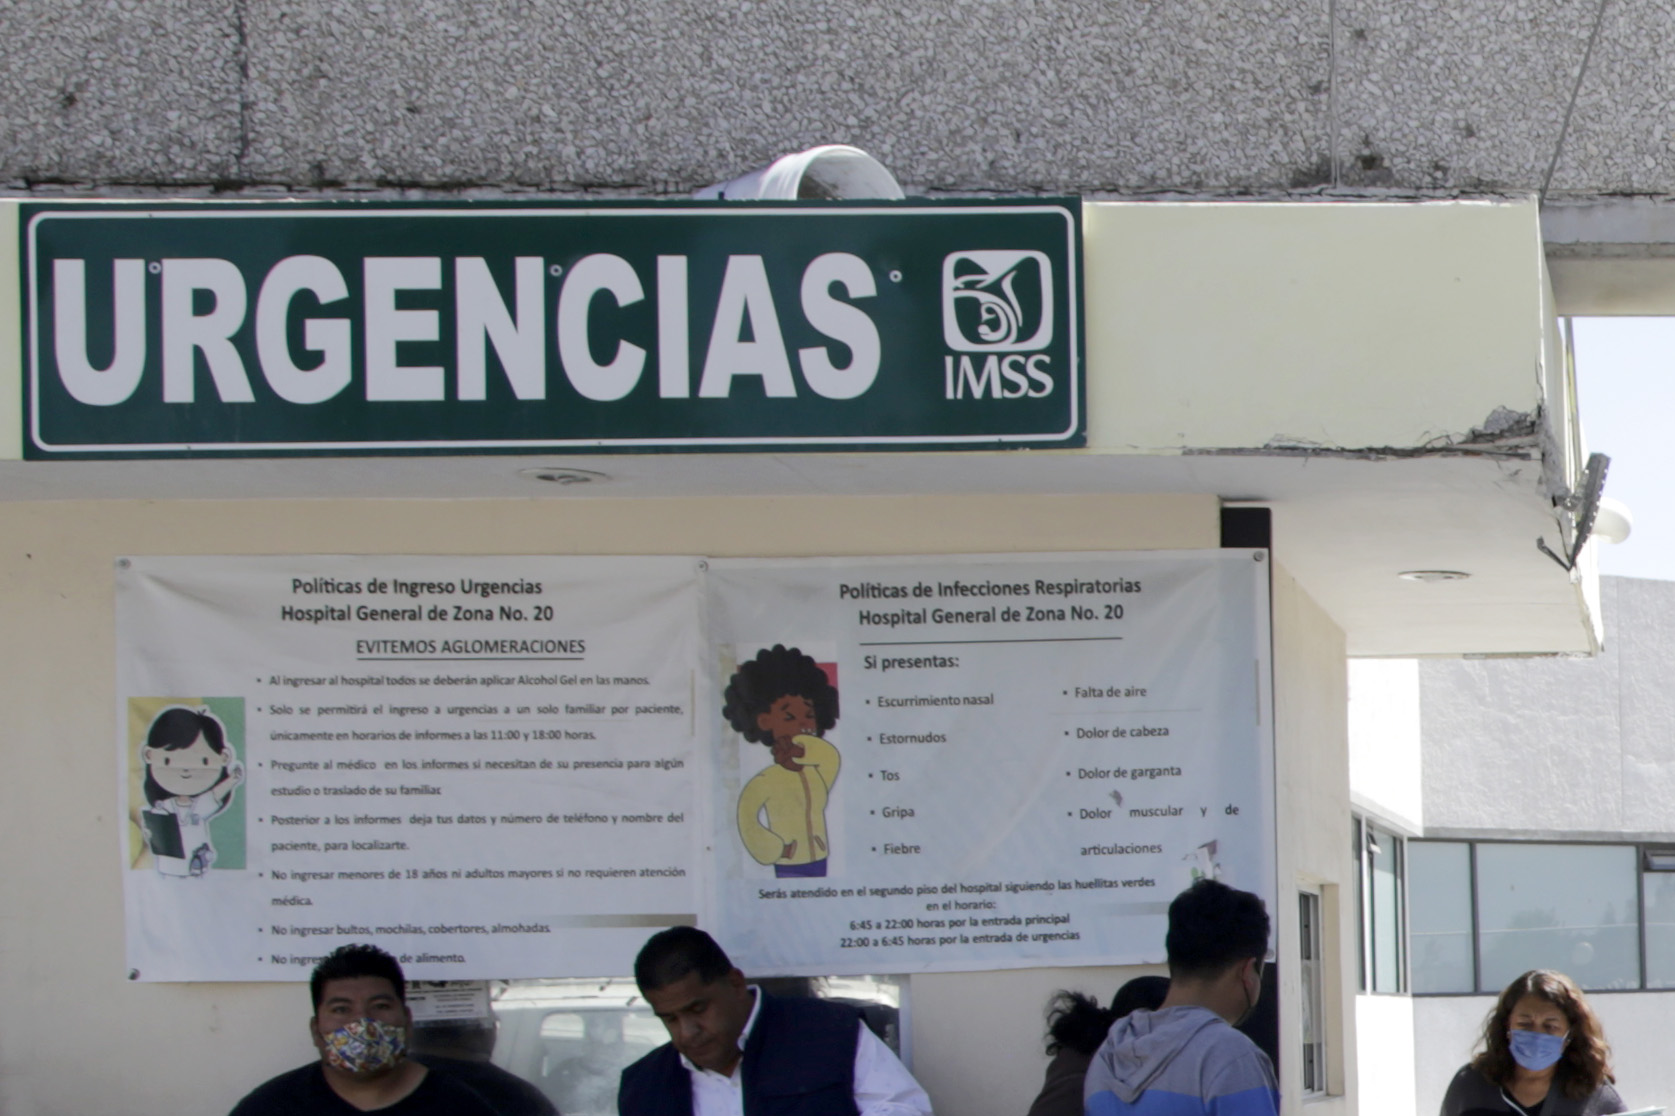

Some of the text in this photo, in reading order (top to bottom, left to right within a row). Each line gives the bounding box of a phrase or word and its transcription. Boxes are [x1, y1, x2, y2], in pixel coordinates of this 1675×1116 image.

[53, 252, 881, 406] URGENCIAS
[944, 354, 1054, 399] IMSS
[291, 577, 543, 599] Políticas de Ingreso Urgencias
[839, 577, 1142, 600] Políticas de Infecciones Respiratorias
[281, 604, 554, 625] Hospital General de Zona No. 20
[858, 603, 1124, 629] Hospital General de Zona No. 20
[357, 640, 585, 654] EVITEMOS AGLOMERACIONES
[864, 655, 960, 673] Si presentas:
[269, 676, 280, 685] Al
[283, 676, 327, 688] ingresar
[329, 676, 338, 685] al
[341, 676, 384, 687] hospital
[385, 676, 417, 685] todos
[433, 675, 478, 685] deberán
[480, 675, 515, 687] aplicar
[517, 675, 557, 685] Alcohol
[559, 675, 577, 685] Gel
[596, 675, 610, 685] las
[1075, 686, 1147, 698] Falta de aire
[878, 693, 994, 707] Escurrimiento nasal
[270, 705, 293, 715] Solo
[299, 707, 311, 715] se
[317, 705, 367, 716] permitirá
[373, 705, 383, 715] el
[389, 705, 429, 717] ingreso
[434, 706, 441, 714] a
[447, 705, 498, 717] urgencias
[537, 704, 559, 714] solo
[565, 704, 606, 714] familiar
[611, 706, 629, 716] por
[635, 704, 683, 715] paciente,
[270, 731, 334, 741] únicamente
[352, 731, 397, 740] horarios
[398, 730, 412, 740] de
[414, 730, 463, 740] informes
[464, 732, 471, 740] a
[473, 730, 488, 740] las
[491, 730, 520, 740] 11:00
[523, 733, 529, 742] y
[533, 730, 562, 740] 18:00
[564, 730, 596, 740] horas.
[880, 732, 947, 744] Estornudos
[1077, 726, 1169, 739] Dolor de cabeza
[880, 770, 900, 781] Tos
[1078, 766, 1181, 780] Dolor de garganta
[882, 806, 915, 819] Gripa
[1079, 804, 1239, 819] Dolor muscular y de
[271, 840, 409, 853] paciente, para localizarte.
[884, 843, 921, 854] Fiebre
[1081, 843, 1162, 856] articulaciones
[272, 870, 287, 880] No
[291, 871, 335, 882] ingresar
[338, 872, 385, 880] menores
[388, 869, 401, 879] de
[406, 869, 418, 879] 18
[422, 869, 448, 879] años
[451, 869, 461, 878] ni
[465, 868, 505, 878] adultos
[508, 870, 553, 880] mayores
[568, 870, 581, 878] no
[585, 868, 636, 879] requieren
[639, 867, 686, 877] atención
[759, 877, 1155, 899] Serás atendido en el segundo piso del hospital siguiendo las huellitas verdes
[926, 900, 996, 911] en el horario:
[850, 920, 872, 930] 6:45
[885, 919, 914, 929] 22:00
[916, 918, 945, 928] horas
[949, 920, 966, 929] por
[970, 917, 978, 926] la
[982, 915, 1022, 926] entrada
[1025, 913, 1070, 927] principal
[271, 925, 287, 935] No
[290, 926, 334, 937] ingresar
[336, 925, 373, 935] bultos,
[375, 924, 426, 935] mochilas,
[428, 924, 489, 934] cobertores,
[840, 931, 1080, 948] 22:00 a 6:45 horas por la entrada de urgencias
[271, 955, 287, 964] No
[289, 954, 325, 966] ingres
[400, 953, 413, 963] de
